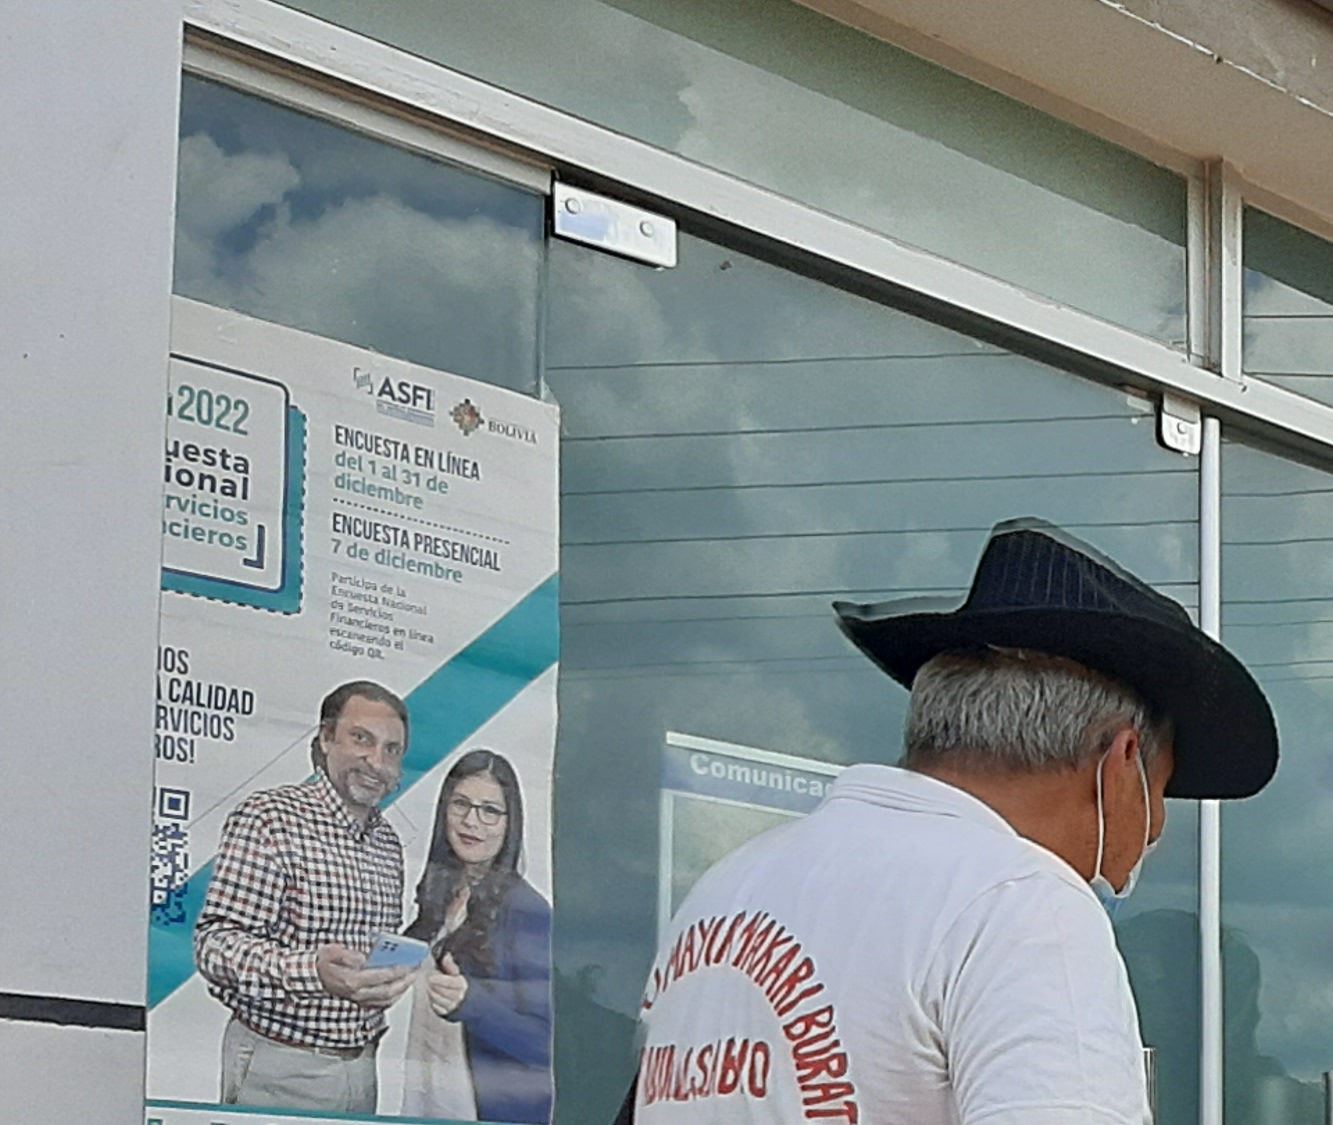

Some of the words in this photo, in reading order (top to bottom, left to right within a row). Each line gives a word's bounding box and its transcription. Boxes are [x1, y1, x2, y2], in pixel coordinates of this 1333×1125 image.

[177, 385, 249, 436] 2022
[377, 376, 433, 411] ASFI
[488, 420, 538, 444] BOLIVIA
[335, 425, 410, 464] ENCUESTA
[414, 447, 434, 469] EN
[439, 450, 480, 481] LÍNEA
[164, 458, 249, 500] ional
[335, 451, 362, 471] del
[368, 460, 376, 475] 1
[382, 465, 396, 482] al
[402, 470, 420, 487] 31
[426, 476, 449, 494] de
[335, 473, 424, 509] diciembre
[332, 512, 410, 549] ENCUESTA
[414, 532, 501, 571] PRESENCIAL
[331, 539, 341, 553] 7
[346, 542, 369, 561] de
[375, 550, 463, 583] diciembre
[332, 572, 377, 591] Participa
[381, 581, 393, 594] de
[332, 585, 378, 605] Encuesta
[382, 597, 427, 615] Nacional
[330, 612, 390, 635] Financieros
[393, 626, 406, 636] en
[348, 602, 393, 621] Servicios
[330, 627, 391, 648] escaneando
[394, 641, 403, 651] el
[330, 640, 364, 656] código
[169, 678, 254, 715] CALIDAD
